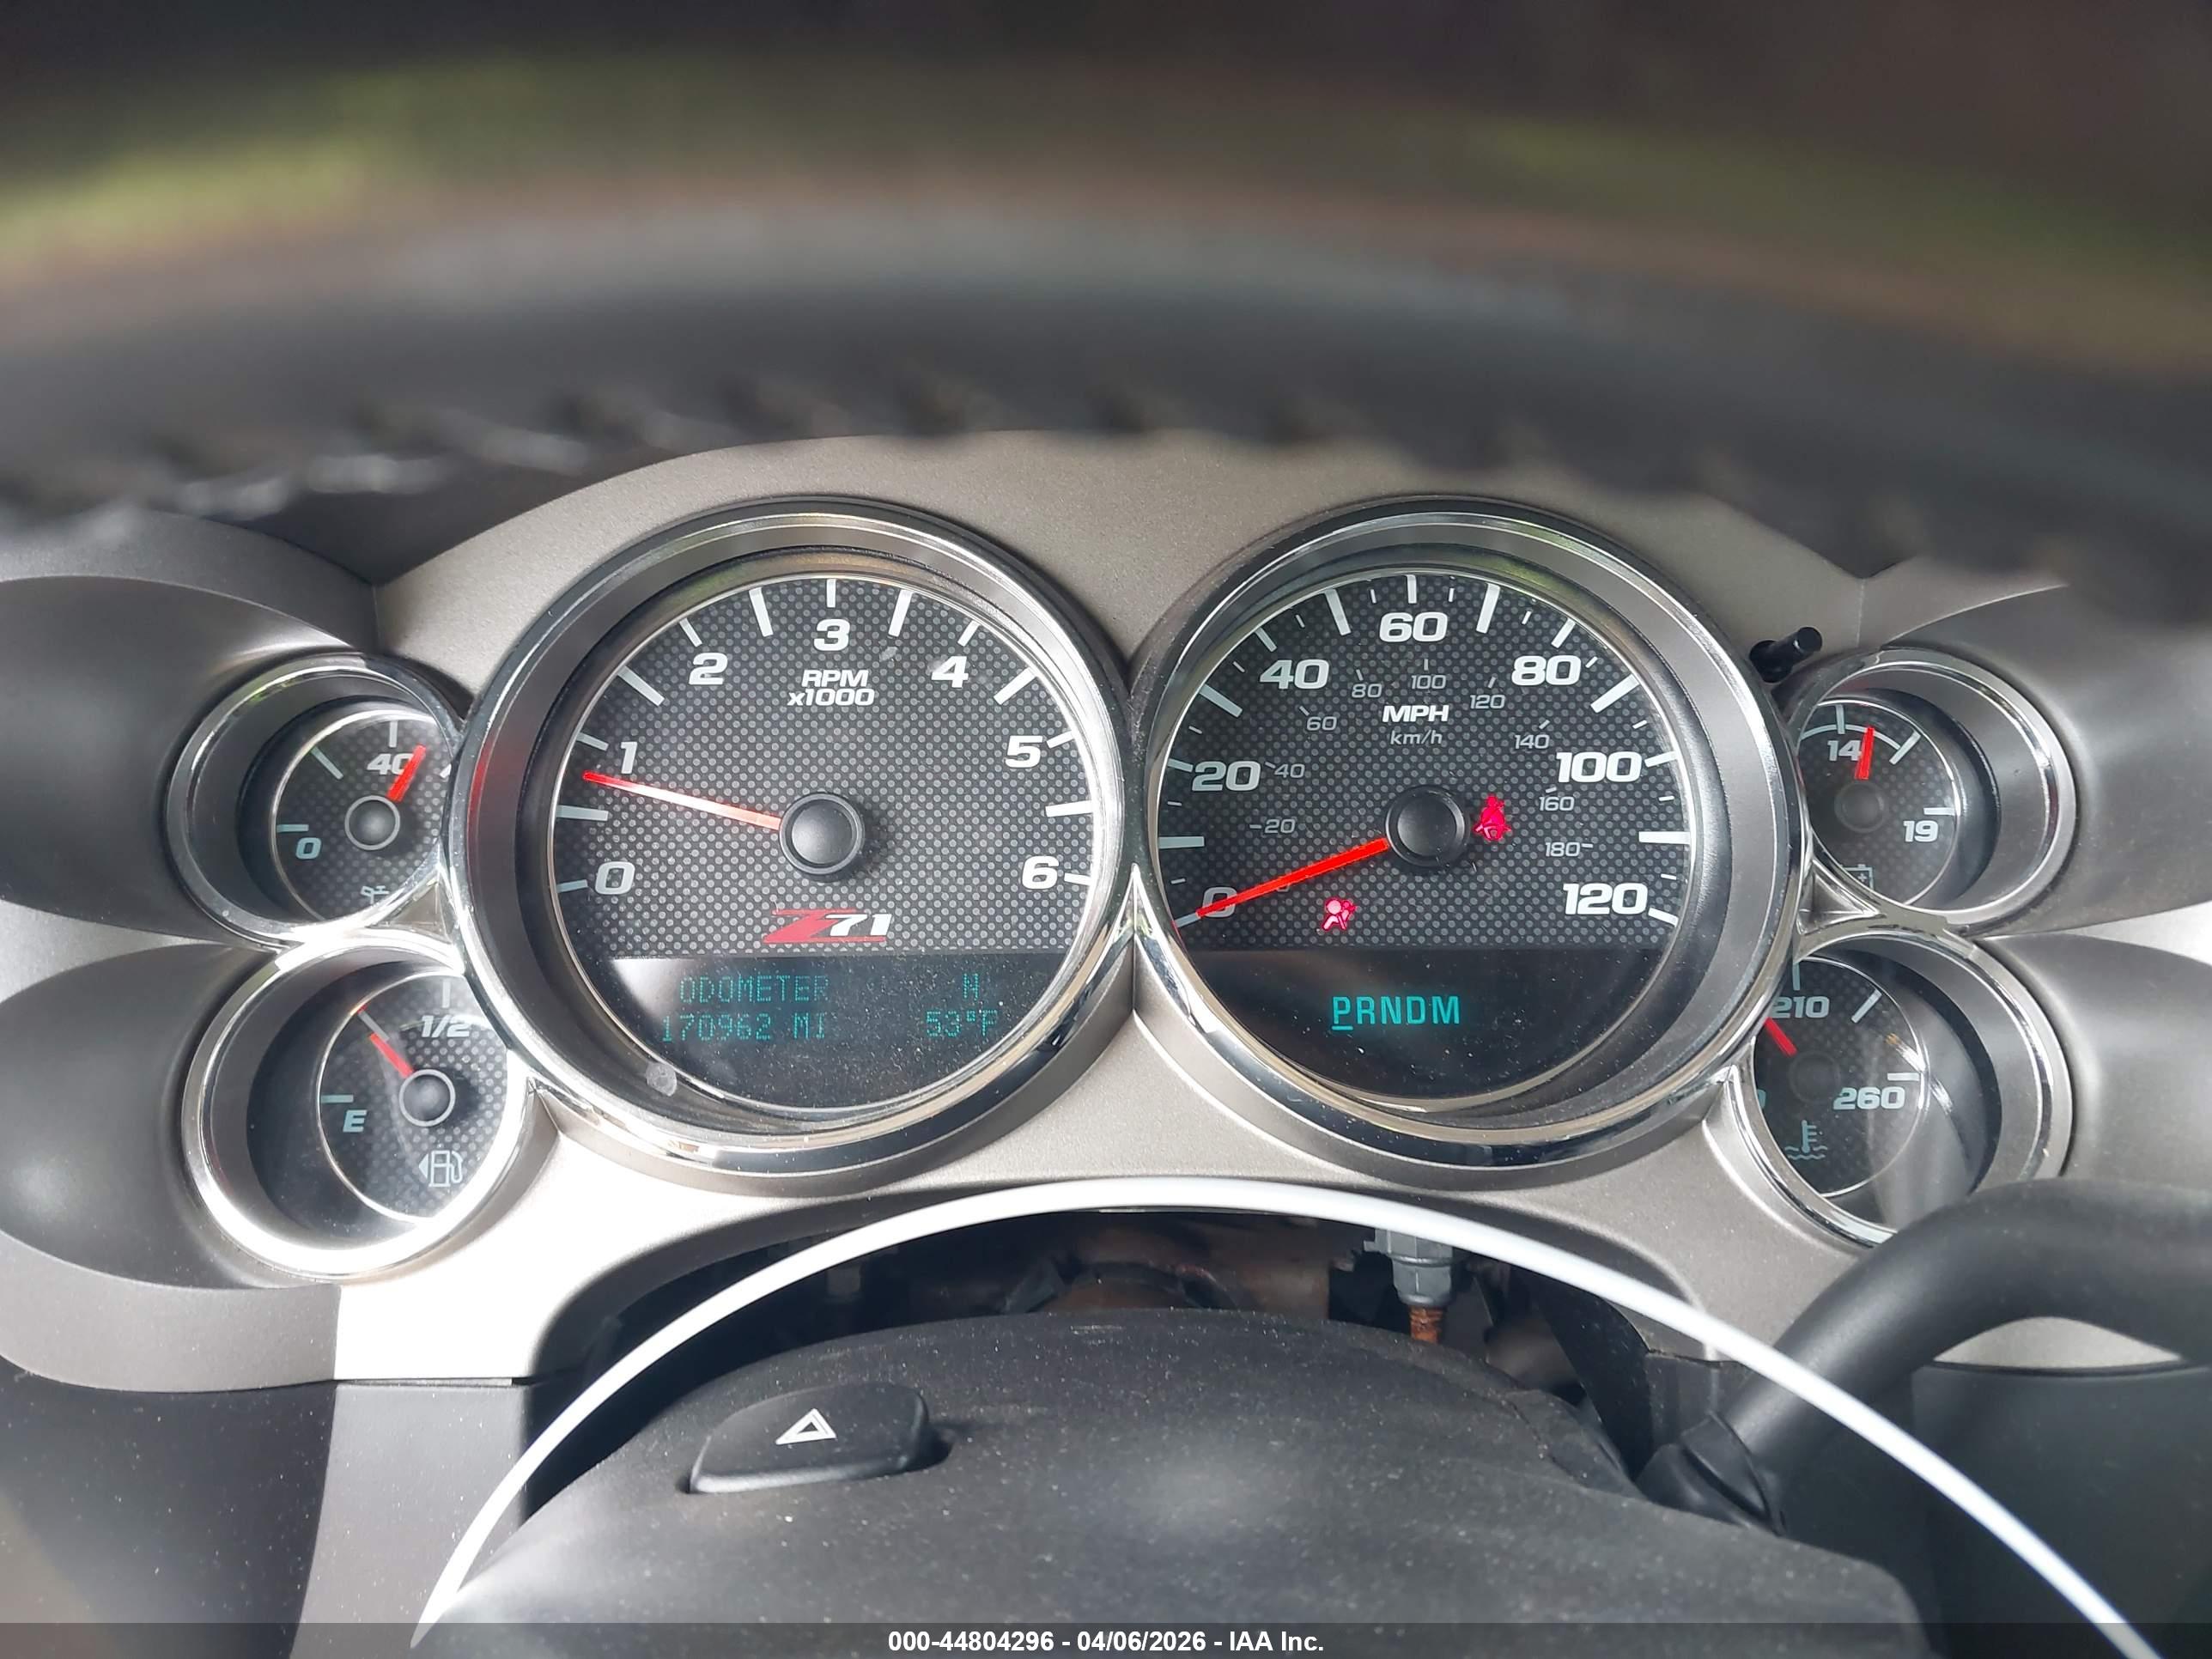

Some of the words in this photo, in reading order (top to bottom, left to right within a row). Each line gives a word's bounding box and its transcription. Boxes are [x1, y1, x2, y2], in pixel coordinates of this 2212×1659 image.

[813, 618, 850, 651] 3
[1379, 612, 1448, 643] 60
[688, 652, 728, 686] 2
[802, 670, 869, 687] RPM
[931, 655, 969, 688] 4
[1259, 659, 1328, 690] 40
[1511, 655, 1581, 685] 80
[1352, 684, 1382, 698] 80
[1411, 675, 1447, 690] 100
[787, 688, 876, 707] x1000
[1470, 694, 1505, 709] 120
[1306, 716, 1337, 731] 60
[1382, 705, 1449, 723] MPH
[1390, 729, 1443, 745] km/h
[1515, 734, 1550, 750] 140
[620, 741, 638, 773] 1
[1005, 735, 1042, 769] 5
[1827, 739, 1861, 761] 14
[367, 753, 414, 775] 40
[1274, 763, 1305, 778] 40
[1556, 751, 1642, 782] 100
[1190, 761, 1261, 792] 20
[1539, 796, 1575, 811] 160
[1264, 818, 1296, 834] 20
[1903, 820, 1939, 842] 19
[295, 837, 322, 860] 0
[1546, 842, 1581, 857] 180
[594, 861, 635, 895] 0
[1022, 855, 1060, 890] 6
[1203, 886, 1237, 917] 0
[1563, 883, 1650, 915] 120
[763, 908, 892, 944] Z71
[680, 975, 829, 1003] ODOMETER
[963, 973, 978, 999] N
[1333, 995, 1459, 1026] PRNDM
[1771, 996, 1830, 1018] 210
[421, 1015, 471, 1037] 1/2
[663, 1012, 771, 1042] 170962
[793, 1012, 825, 1040] MI
[1832, 1087, 1905, 1109] 260
[343, 1109, 368, 1133] E
